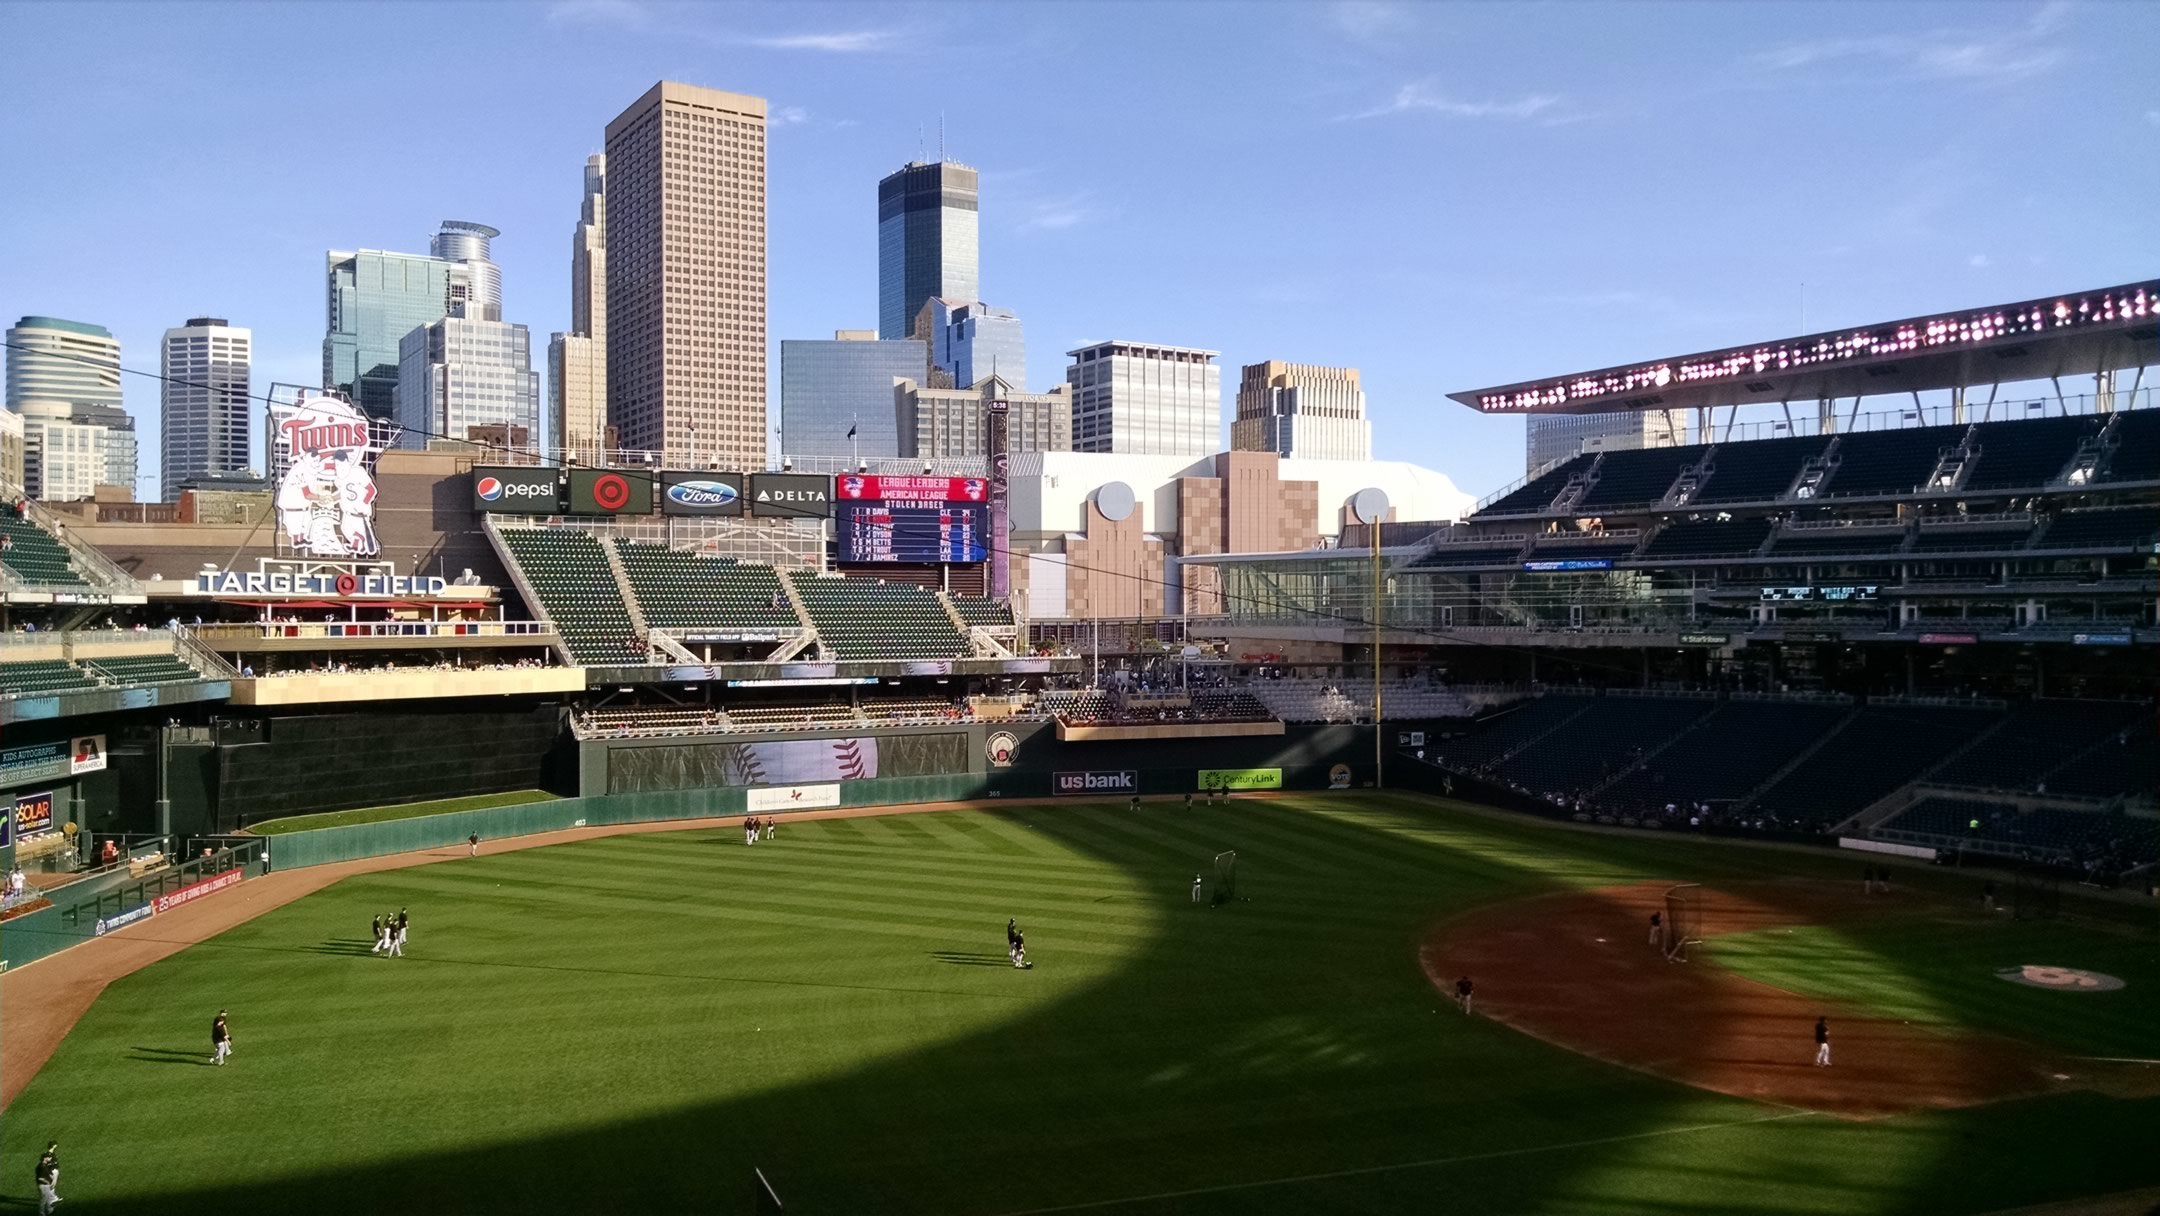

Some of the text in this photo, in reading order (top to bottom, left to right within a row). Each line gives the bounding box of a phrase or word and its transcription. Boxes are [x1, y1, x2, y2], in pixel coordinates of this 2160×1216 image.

[281, 416, 368, 458] Twins
[878, 477, 950, 488] LEAGUE LEADERS
[505, 482, 554, 499] pepsi
[681, 486, 724, 504] Ford
[775, 490, 825, 502] DELTA
[880, 489, 949, 500] AMERICAN LEAGUE
[885, 500, 944, 509] STOLEN BASES
[873, 553, 898, 561] RAMIREZ
[200, 571, 447, 595] TARGET FIELD
[3, 746, 57, 762] KIDS AUTOGRAPHS
[21, 768, 42, 779] SELECT
[42, 764, 60, 775] SEATS
[1223, 774, 1275, 785] CenturyLink
[18, 818, 50, 831] us-solar.com
[159, 896, 169, 911] 25
